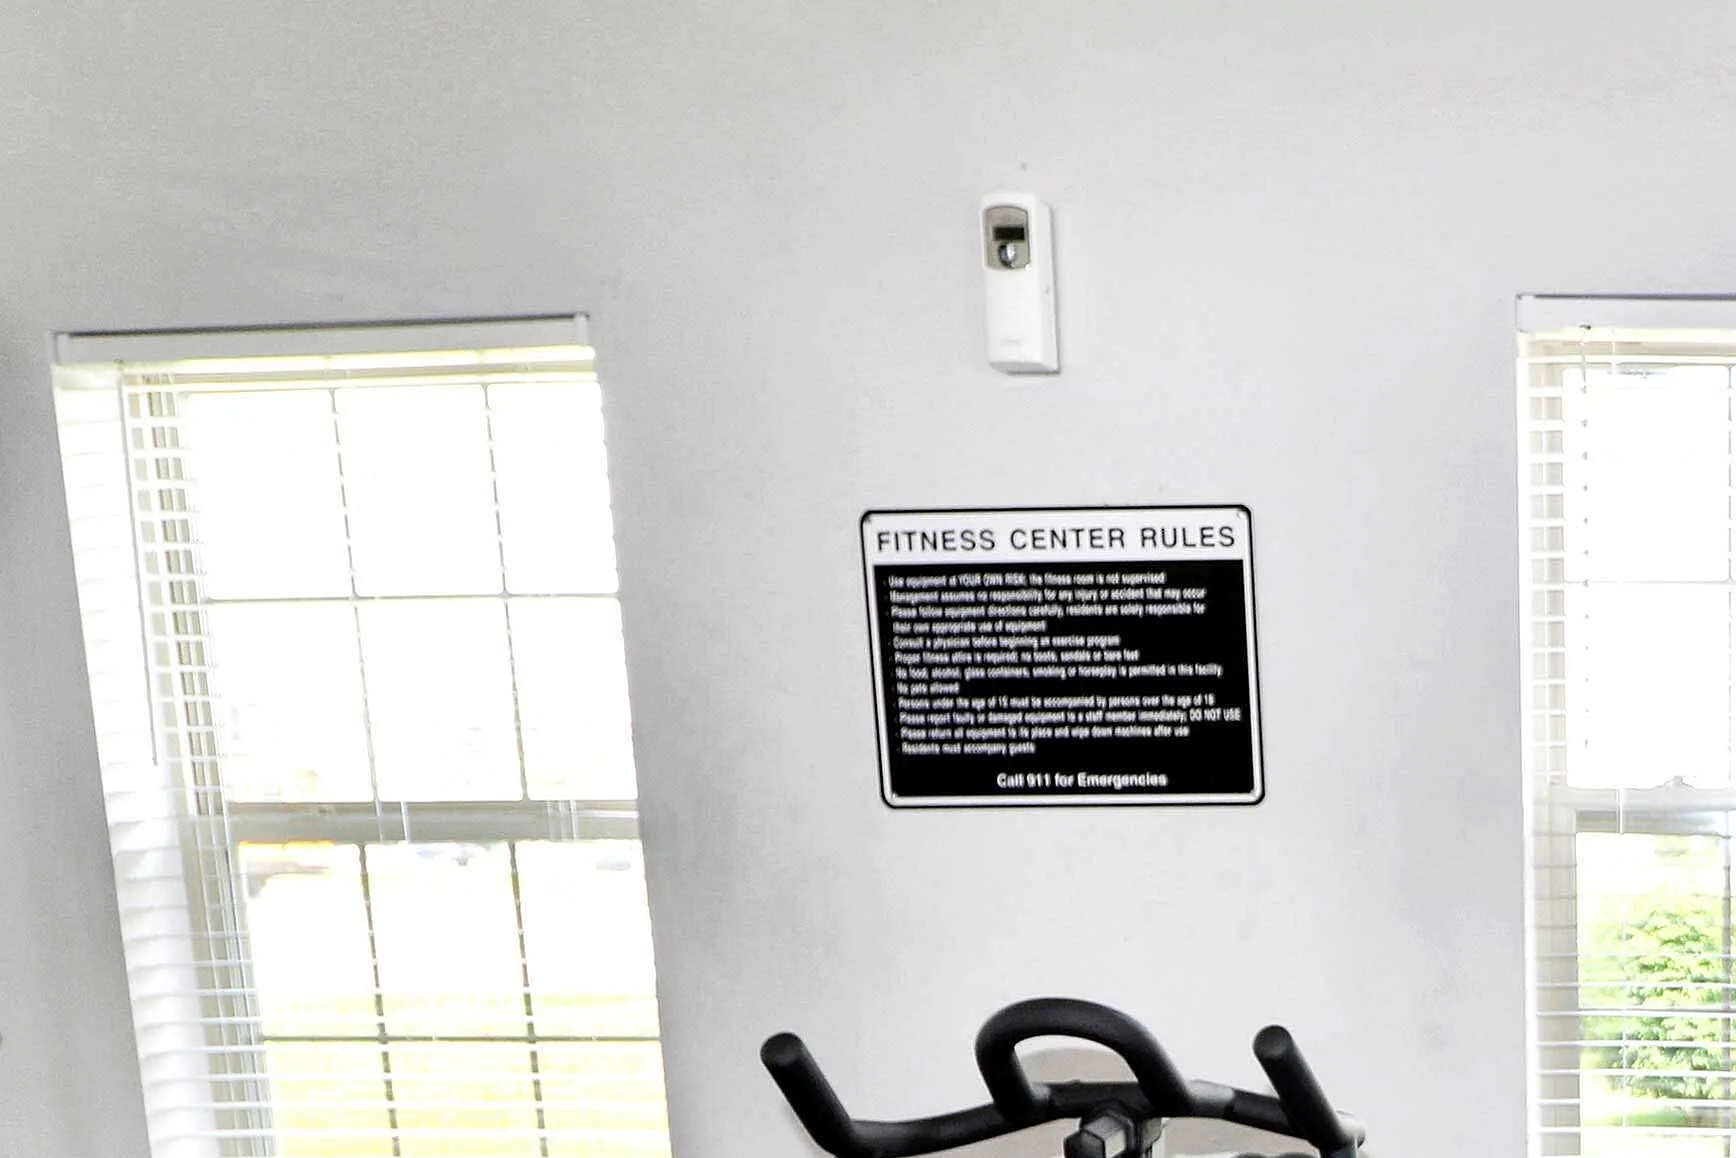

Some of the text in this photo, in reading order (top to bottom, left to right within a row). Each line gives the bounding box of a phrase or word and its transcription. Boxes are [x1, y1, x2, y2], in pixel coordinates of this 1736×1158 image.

[876, 526, 1236, 552] FITNESS CENTER RULES
[996, 771, 1168, 790] Call 911 for Emergencies
